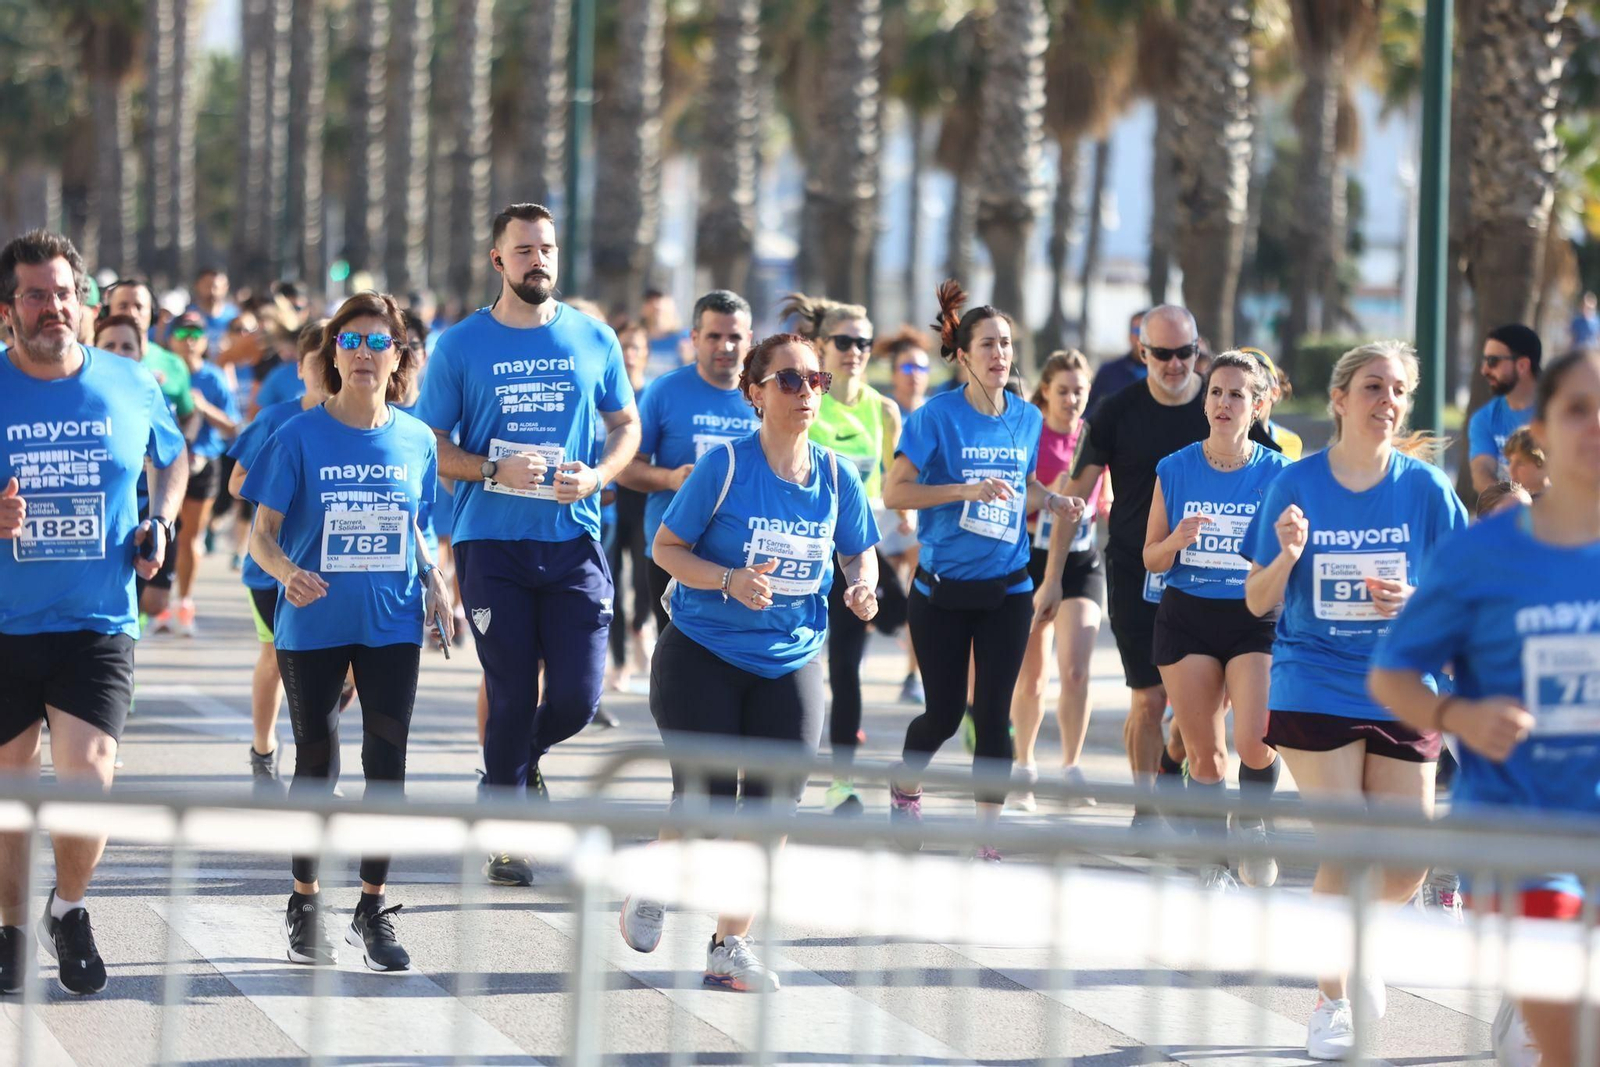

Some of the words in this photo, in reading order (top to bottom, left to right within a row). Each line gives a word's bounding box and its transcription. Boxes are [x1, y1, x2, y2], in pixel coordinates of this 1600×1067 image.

[492, 355, 575, 376] mayoral
[495, 382, 571, 396] RUNNING
[503, 392, 564, 404] MAKES
[502, 403, 565, 414] FRIENDS
[6, 416, 112, 442] mayoral
[9, 449, 108, 466] RUNNING
[962, 446, 1027, 462] mayoral
[20, 461, 100, 477] MAKES
[320, 463, 408, 483] mayoral
[19, 474, 101, 489] FRIENDS
[71, 496, 99, 505] mayoral
[320, 490, 406, 503] RUNNING
[28, 501, 55, 510] Carrera
[28, 507, 60, 515] Solidaria
[977, 504, 1010, 526] 886
[25, 519, 94, 538] 1823
[338, 524, 366, 532] Solidaria
[748, 516, 836, 536] mayoral
[341, 534, 388, 553] 762
[766, 539, 791, 549] Carrera
[1313, 523, 1410, 550] mayoral
[765, 545, 794, 555] Solidaria
[767, 557, 812, 579] 725
[1330, 562, 1357, 570] Carrera
